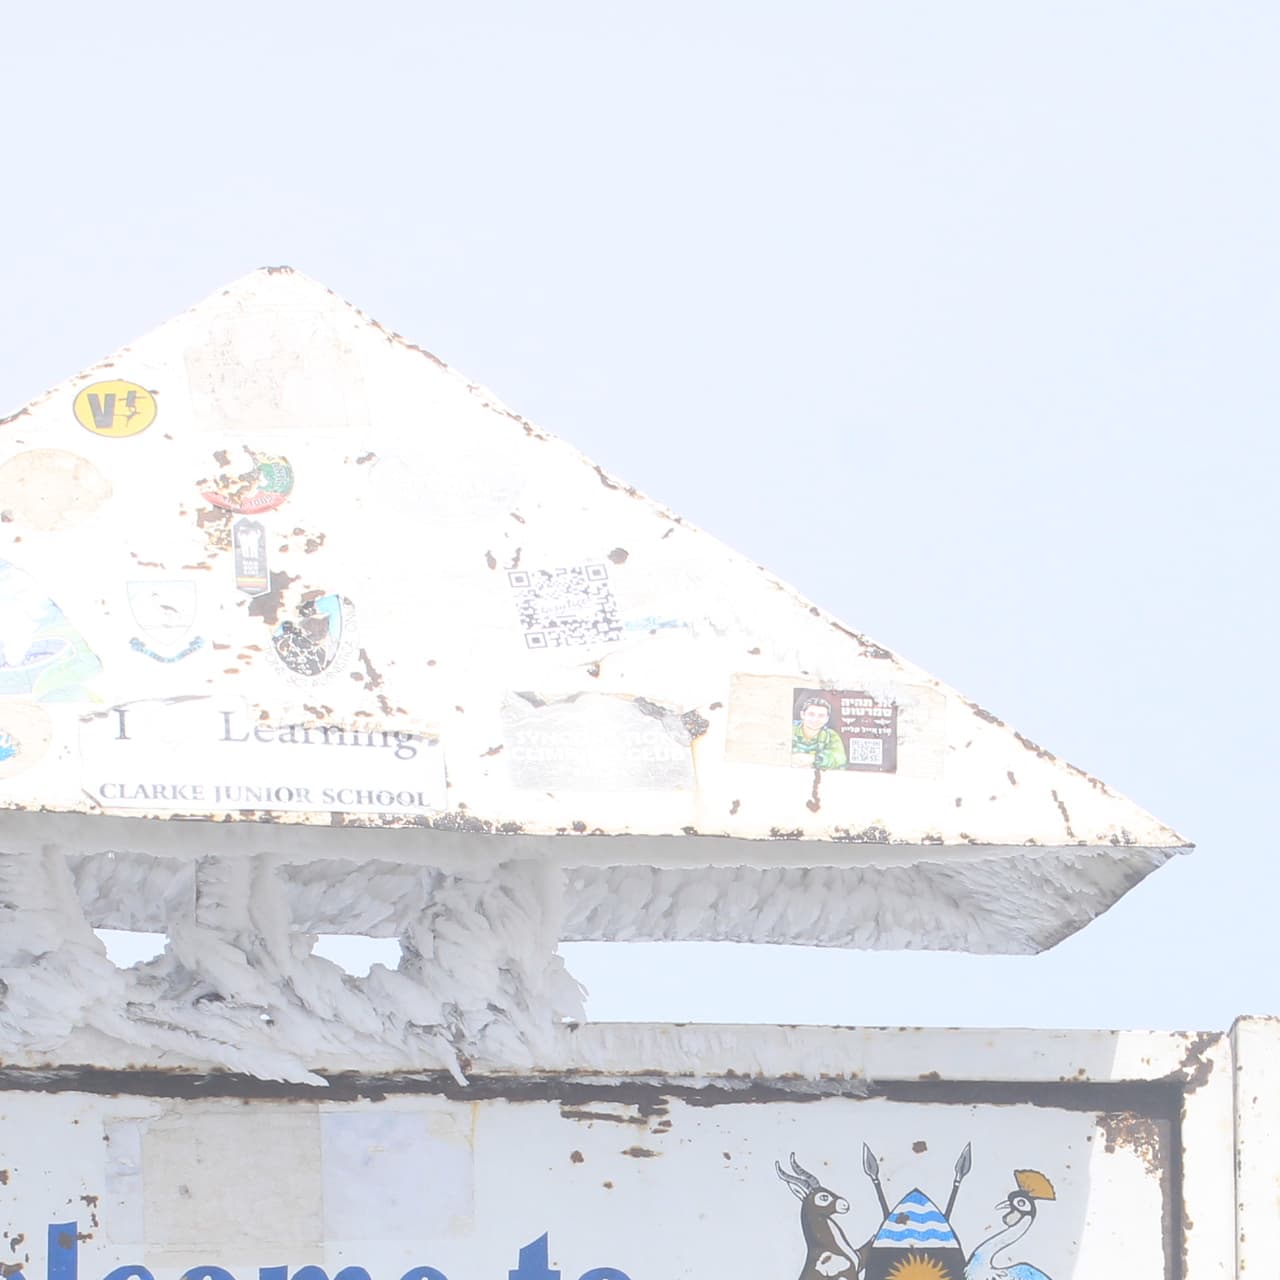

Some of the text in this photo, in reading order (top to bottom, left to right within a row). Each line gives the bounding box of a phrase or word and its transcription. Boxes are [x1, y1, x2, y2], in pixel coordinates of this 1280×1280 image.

[114, 709, 419, 761] I Learning
[99, 783, 431, 808] CLARKE JUNIOR SCHOOL
